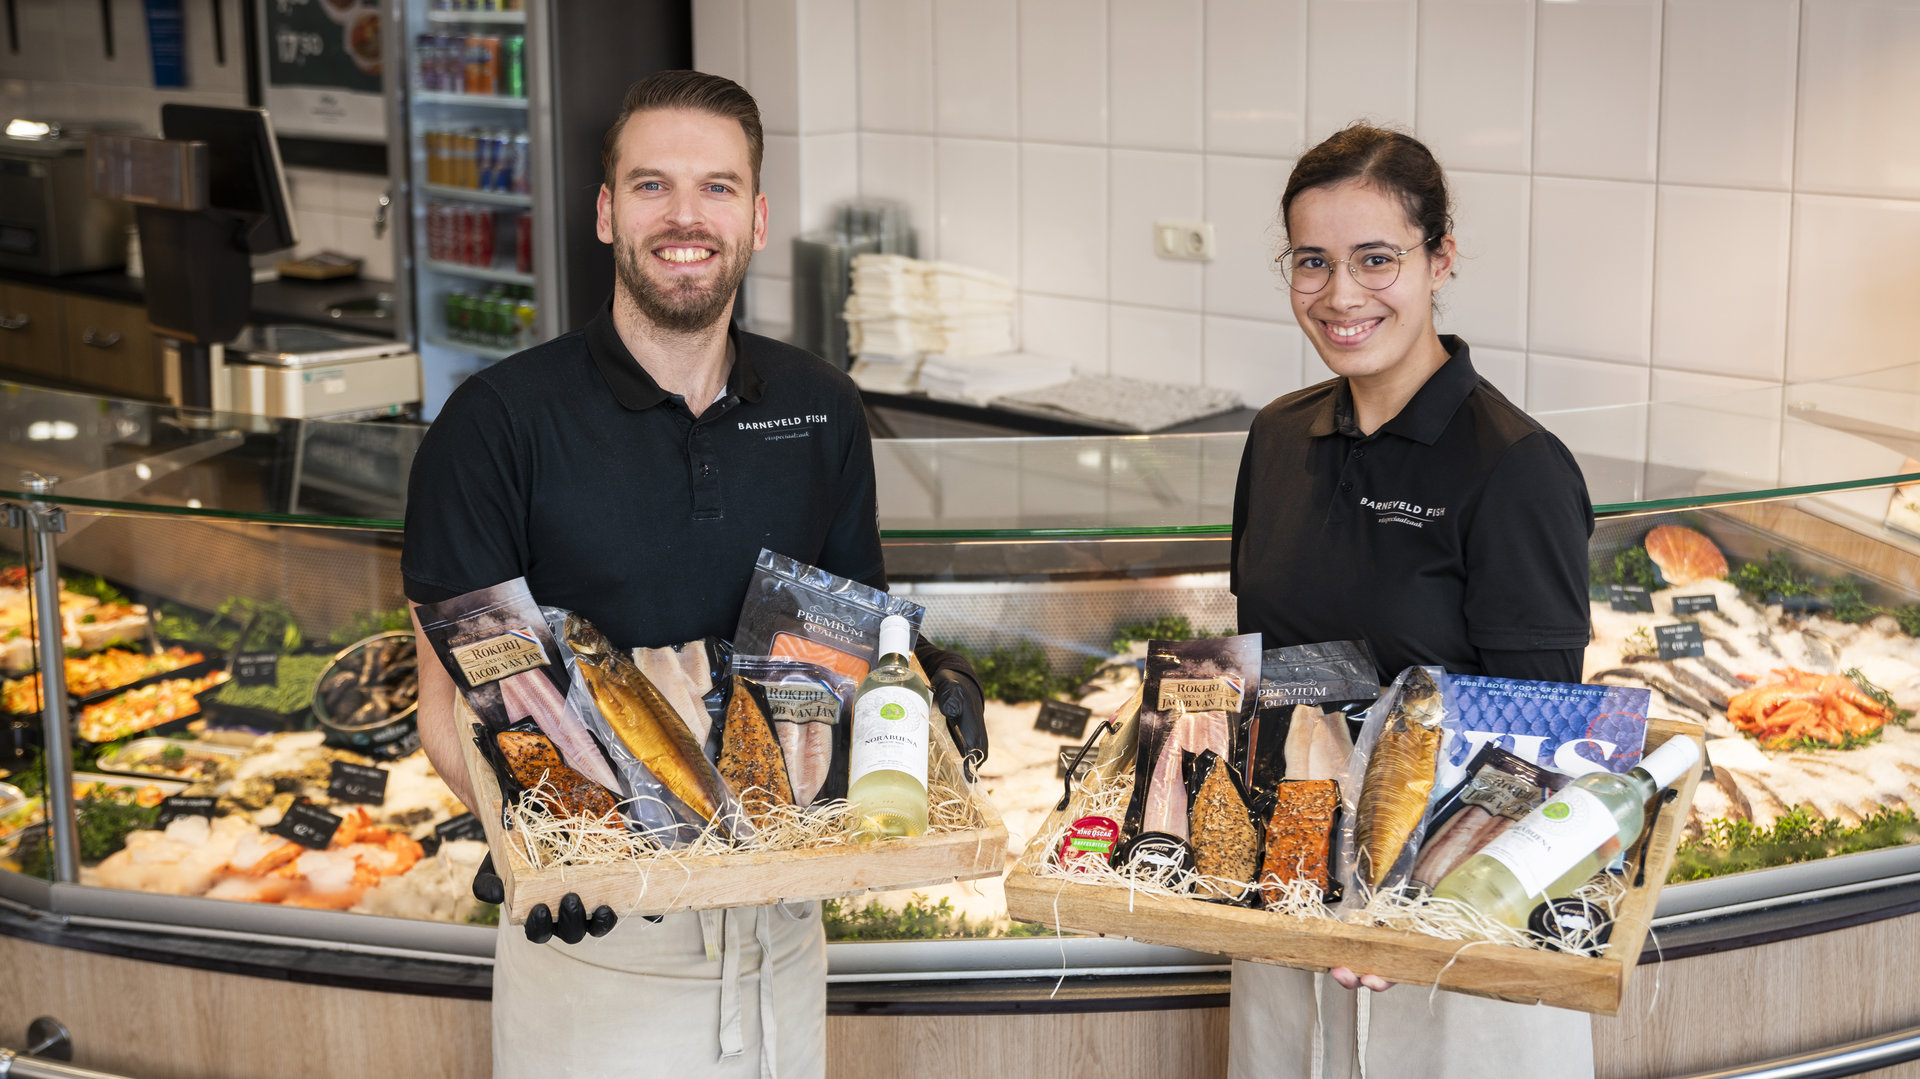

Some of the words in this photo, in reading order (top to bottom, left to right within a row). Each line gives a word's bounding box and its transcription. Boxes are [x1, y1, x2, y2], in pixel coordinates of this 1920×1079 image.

[738, 417, 802, 430] BARNEVELD
[805, 414, 828, 424] FISH
[1360, 497, 1422, 514] BARNEVELD
[1425, 507, 1446, 517] FISH
[797, 608, 864, 638] PREMIUM
[803, 622, 854, 644] QUALITY
[471, 639, 521, 660] ROKERIJ
[468, 664, 501, 684] JACOB
[500, 657, 521, 671] VAN
[523, 652, 543, 666] JAN
[768, 687, 825, 702] ROKERIJ
[1259, 686, 1328, 698] PREMIUM
[1454, 680, 1510, 690] DUBBELBOEK
[1512, 684, 1538, 692] VOOR
[1540, 686, 1569, 694] GROTE
[1571, 688, 1619, 698] GENIETERS
[1502, 691, 1533, 699] KLEINE
[1535, 693, 1581, 702] SMULLERS
[1195, 699, 1216, 708] VAN
[789, 707, 813, 719] VAN
[815, 705, 836, 719] JAN
[864, 734, 918, 749] NORABUENA
[1091, 829, 1113, 838] OSCAR
